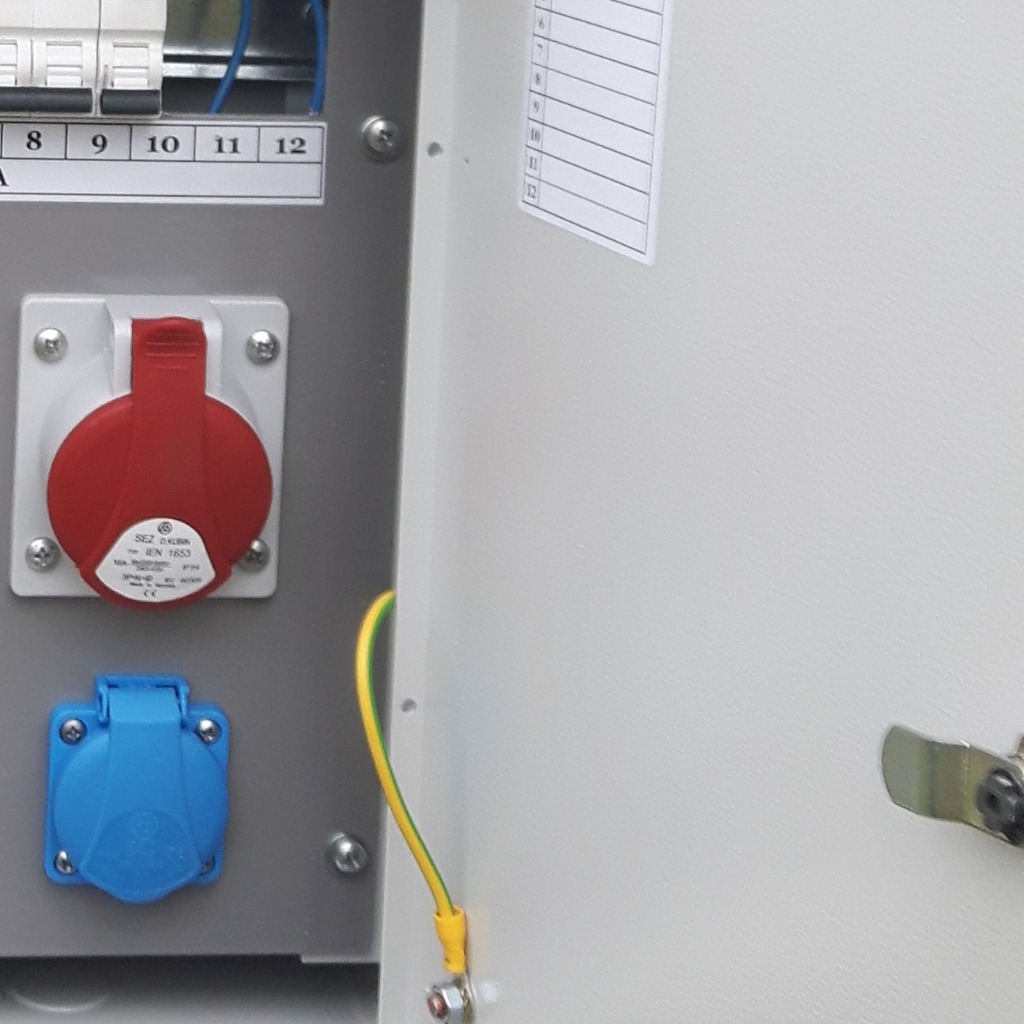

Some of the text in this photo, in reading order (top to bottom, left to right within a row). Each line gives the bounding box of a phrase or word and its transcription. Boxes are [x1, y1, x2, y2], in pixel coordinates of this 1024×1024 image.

[538, 17, 546, 31] 6
[26, 130, 43, 151] 8
[91, 133, 109, 154] 9
[530, 127, 541, 143] 10
[147, 135, 181, 154] 10
[213, 134, 240, 155] 11
[275, 136, 308, 155] 12
[528, 155, 538, 171] 11
[527, 183, 537, 200] 12
[134, 534, 156, 544] SEZ
[145, 548, 163, 557] IEN
